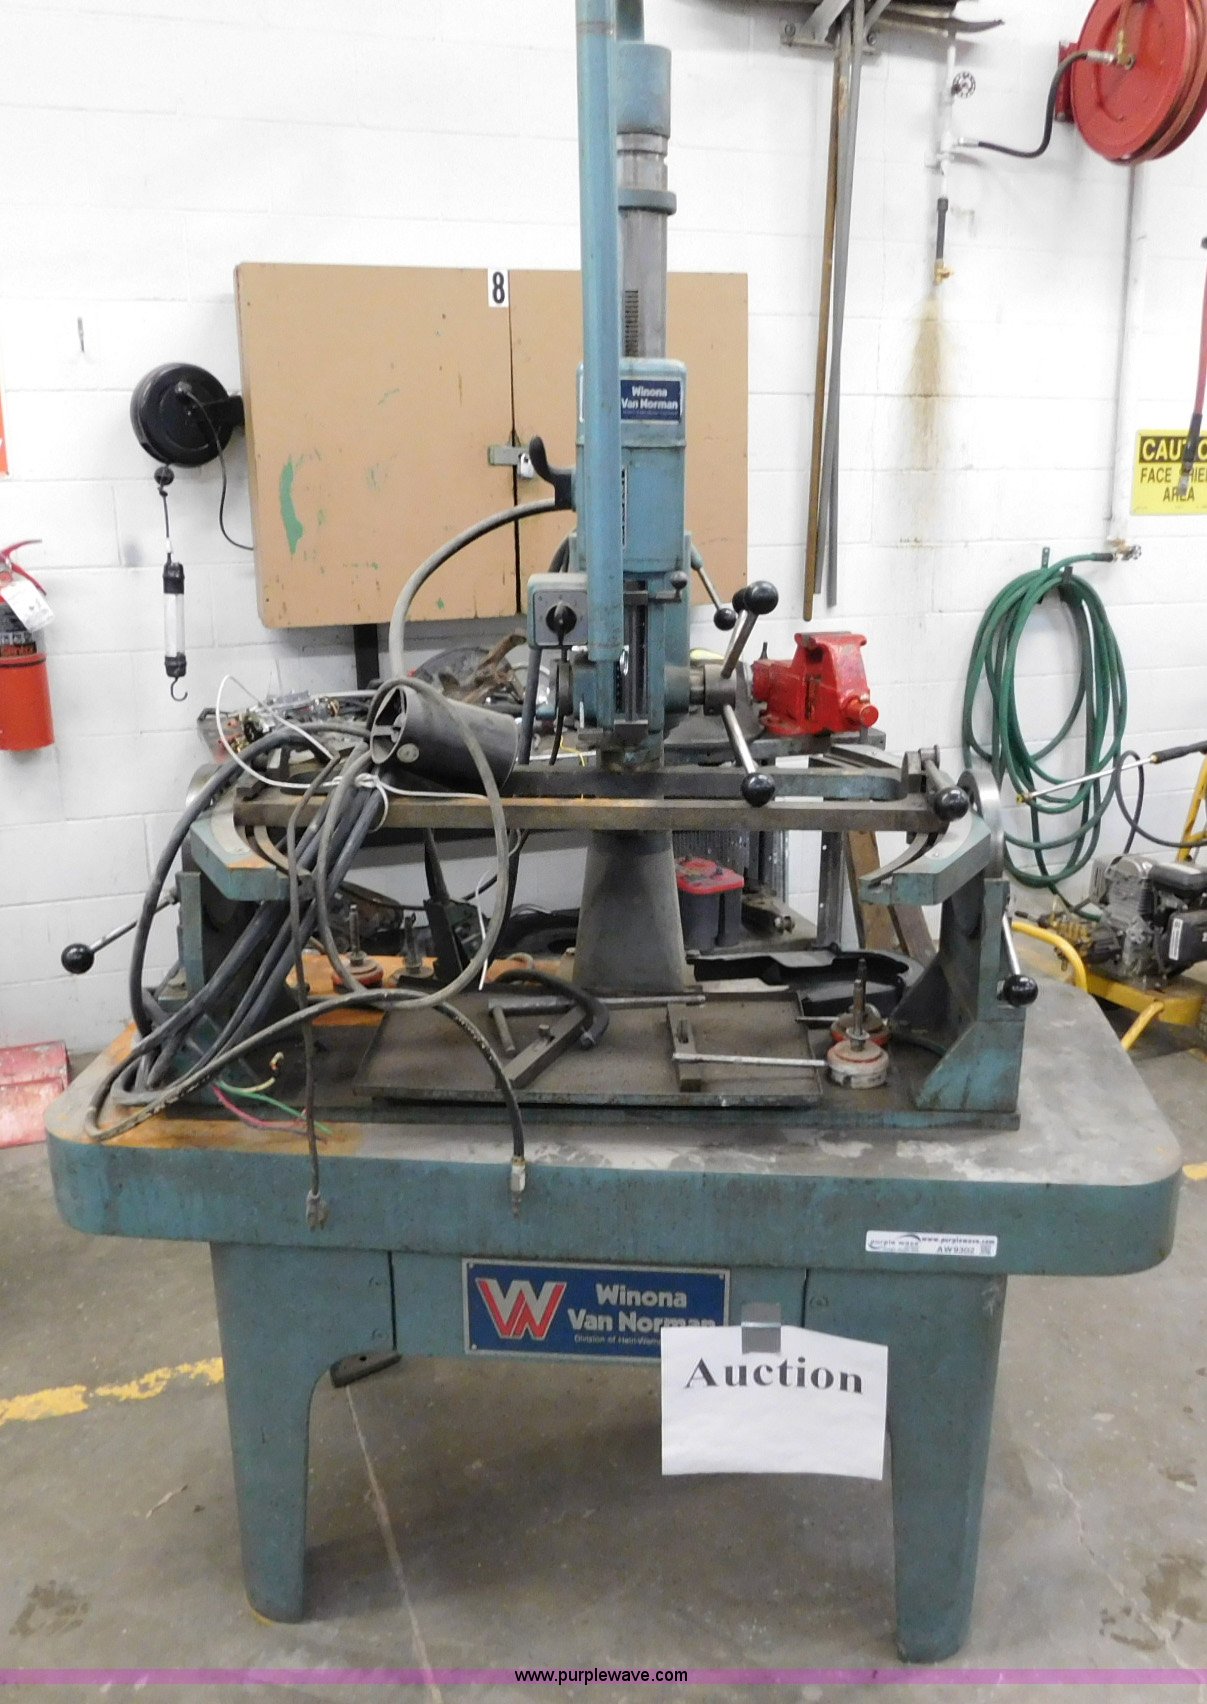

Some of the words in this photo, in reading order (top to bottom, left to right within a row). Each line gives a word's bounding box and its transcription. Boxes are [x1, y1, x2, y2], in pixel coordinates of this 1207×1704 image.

[493, 271, 505, 304] 8
[632, 386, 667, 397] Winona
[621, 398, 639, 409] Van
[640, 398, 679, 410] Norman
[1141, 467, 1172, 483] FACE
[595, 1283, 688, 1308] Winona
[567, 1308, 613, 1332] Van
[684, 1355, 864, 1394] Auction
